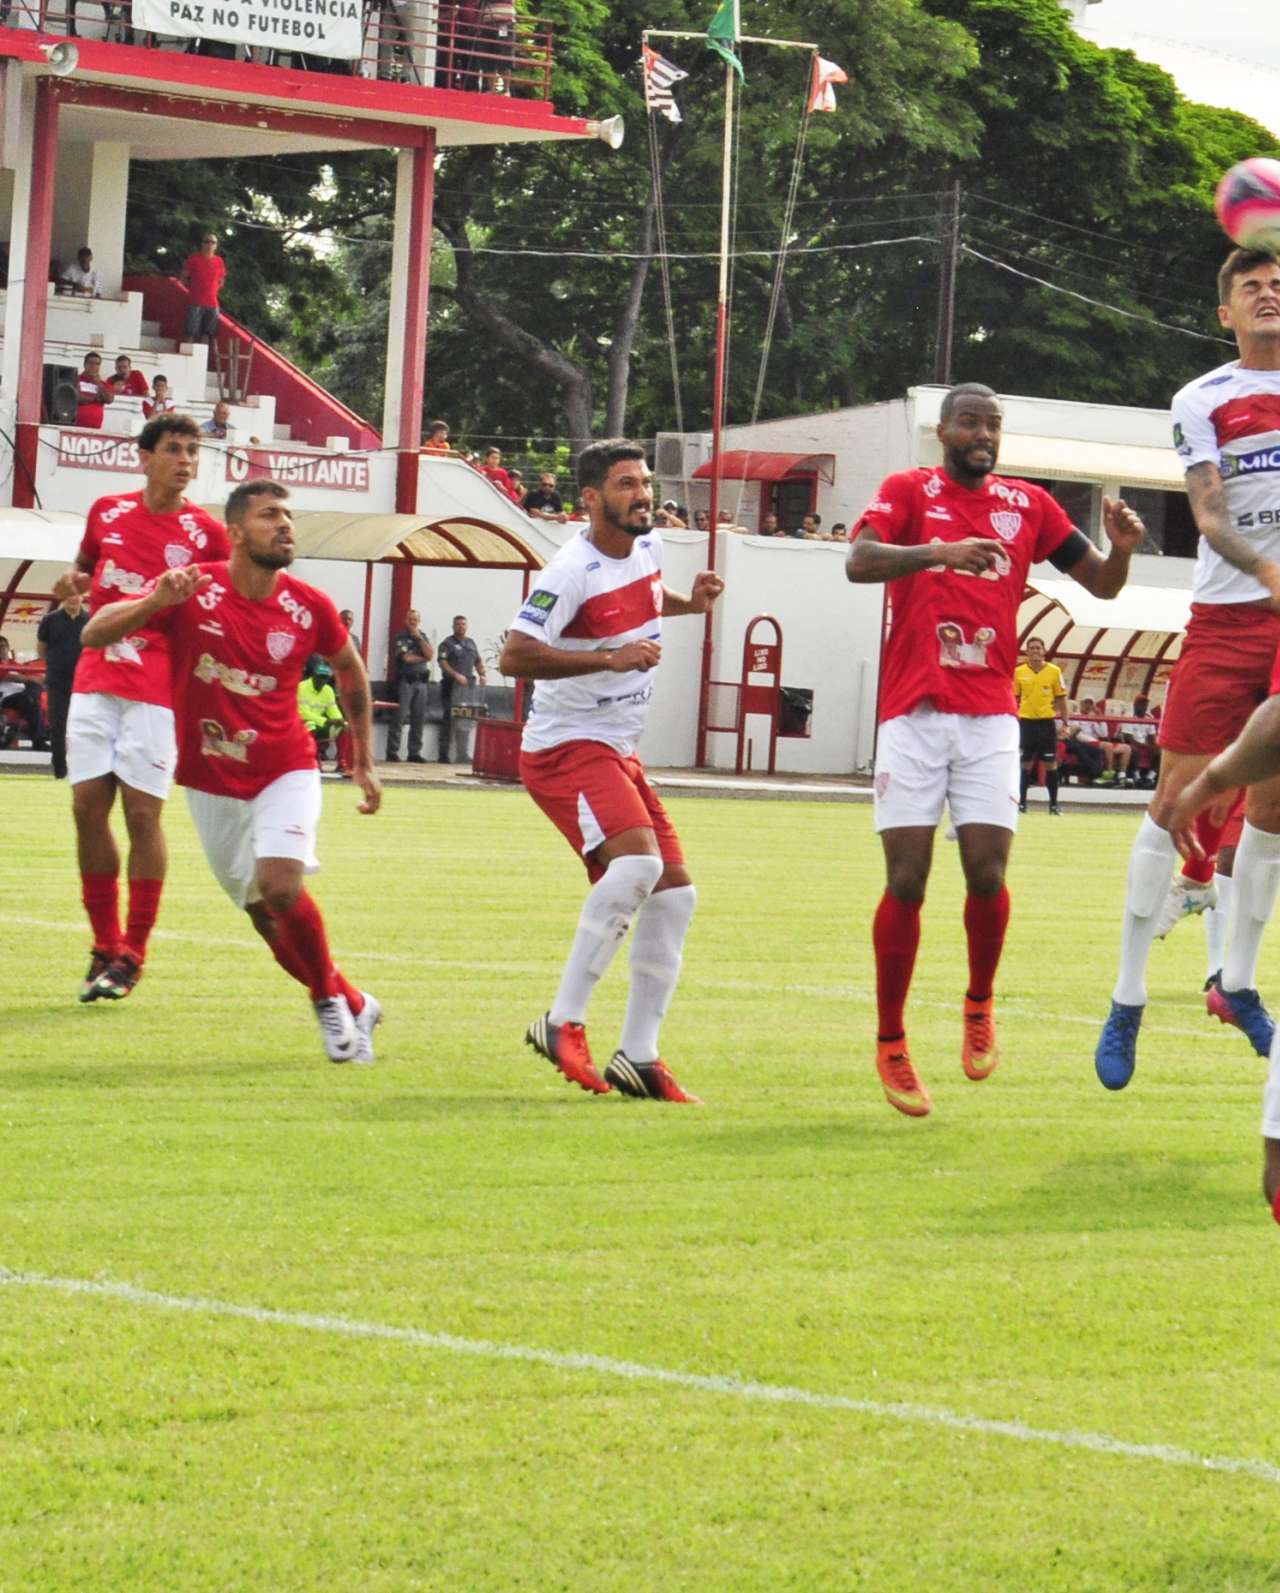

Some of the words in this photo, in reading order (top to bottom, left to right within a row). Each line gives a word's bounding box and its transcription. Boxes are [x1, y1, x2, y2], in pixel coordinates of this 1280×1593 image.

[170, 2, 204, 22] PAZ
[212, 8, 239, 27] NO
[248, 14, 326, 39] FUTEBOL
[61, 436, 141, 468] NOROES
[268, 456, 366, 486] VISITANTE
